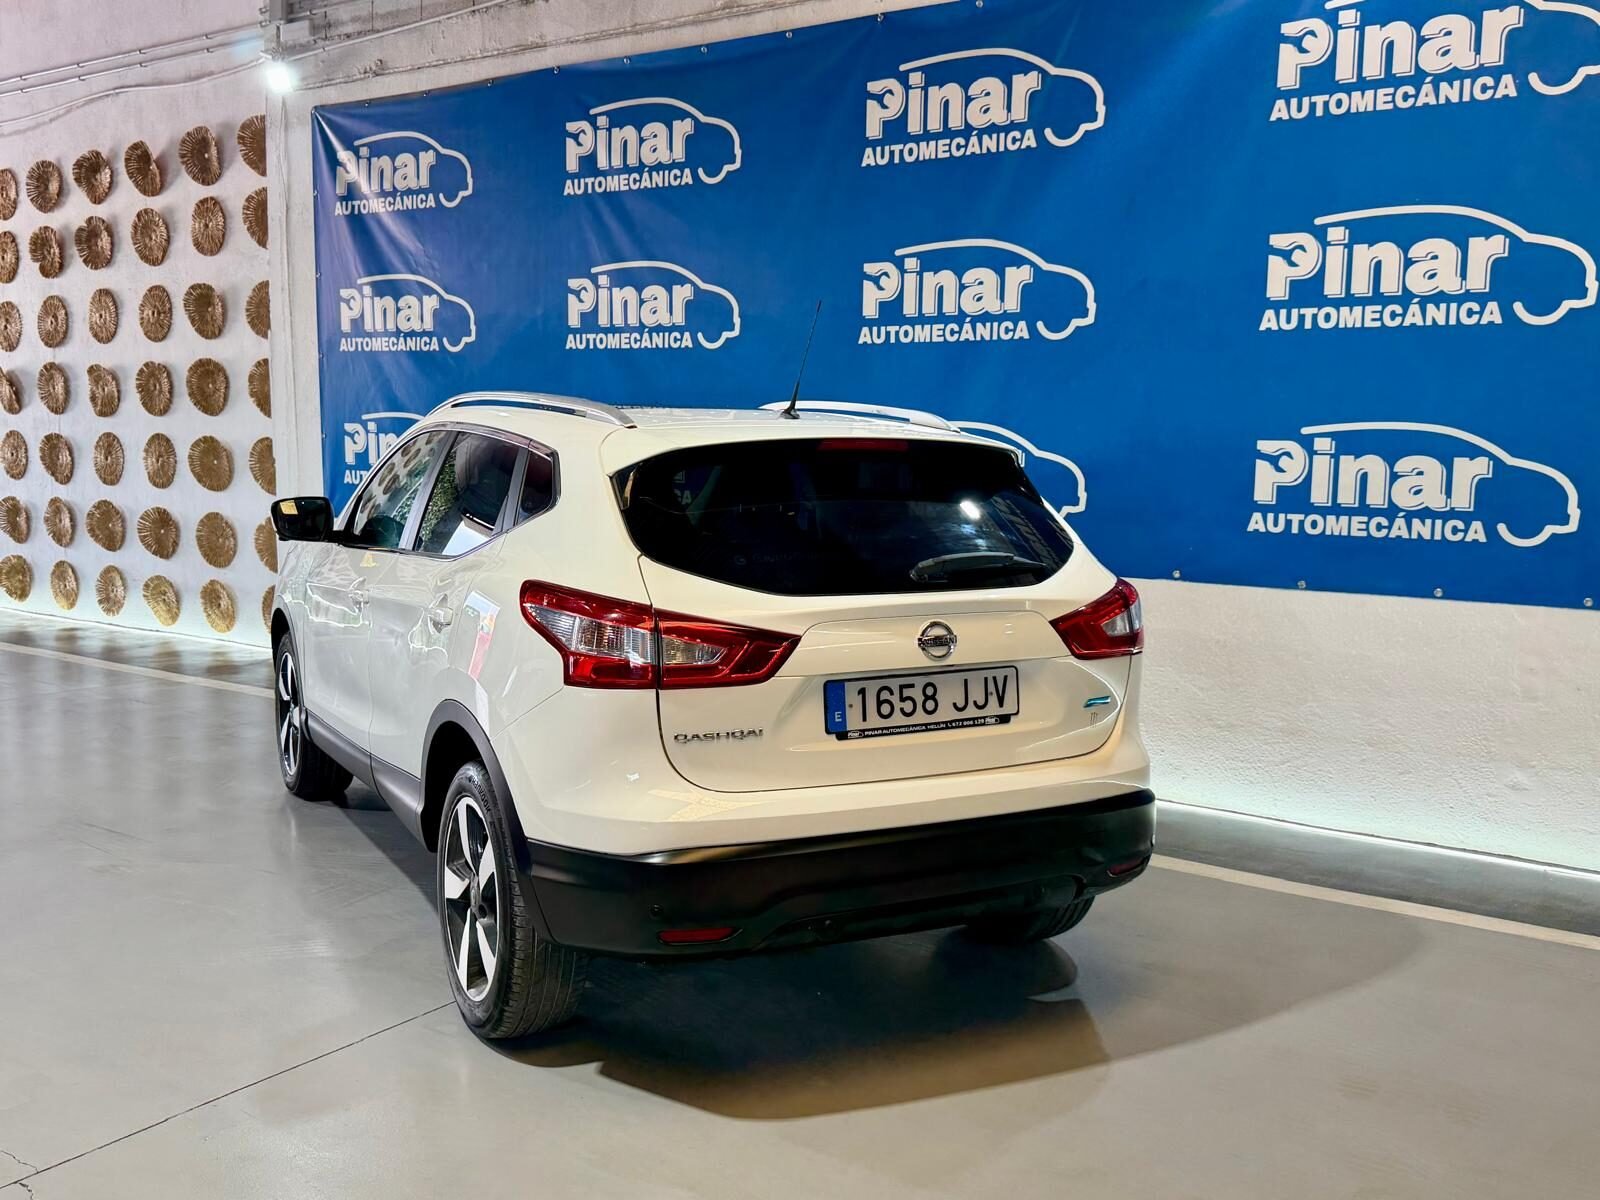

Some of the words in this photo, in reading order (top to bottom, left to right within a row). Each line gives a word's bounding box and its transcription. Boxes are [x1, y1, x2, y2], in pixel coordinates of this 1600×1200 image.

[1276, 4, 1524, 89] Pinar
[865, 69, 1042, 140] Pinar
[1269, 73, 1517, 122] AUTOMECÁNICA
[565, 116, 694, 173] Pinar
[861, 128, 1036, 167] AUTOMECÁNICA
[336, 147, 436, 196] Pinar
[563, 167, 693, 196] AUTOMECÁNICA
[334, 193, 435, 216] AUTOMECÁNICA
[1265, 227, 1509, 300] Pinar
[339, 286, 440, 332] Pinar
[567, 275, 694, 329] Pinar
[862, 257, 1033, 320] Pinar
[858, 316, 1029, 345] AUTOMECÁNICA
[1259, 297, 1502, 331] AUTOMECÁNICA
[339, 333, 439, 352] AUTOMECÁNICA
[565, 328, 693, 350] AUTOMECÁNICA
[344, 421, 399, 466] Pin
[1252, 437, 1493, 512] Pinar
[1247, 511, 1487, 543] AUTOMECÁNICA
[834, 711, 842, 722] E
[857, 681, 938, 722] 1658
[952, 674, 1009, 713] JJV
[674, 728, 764, 744] QASHQAI
